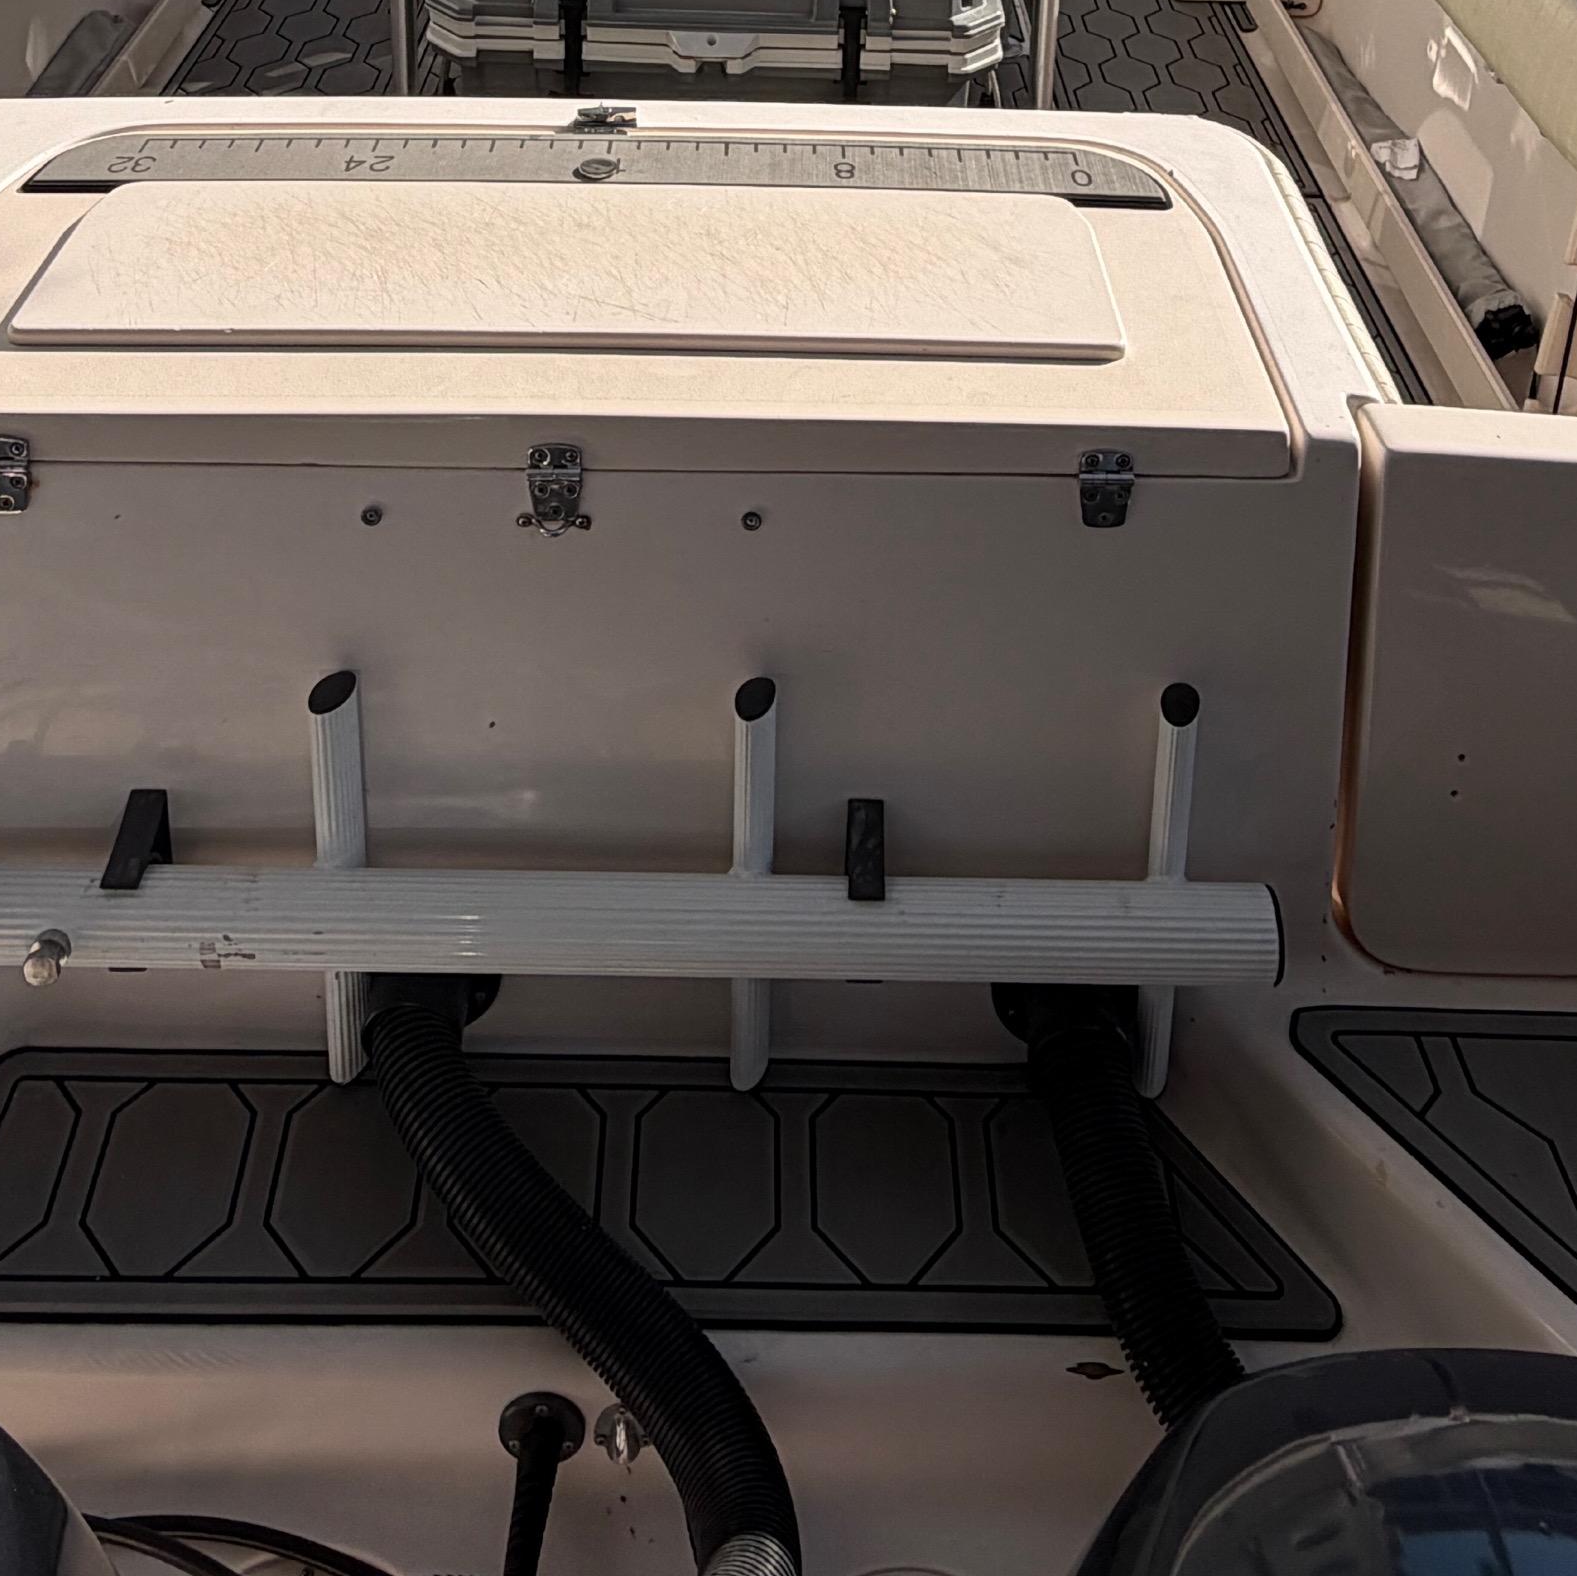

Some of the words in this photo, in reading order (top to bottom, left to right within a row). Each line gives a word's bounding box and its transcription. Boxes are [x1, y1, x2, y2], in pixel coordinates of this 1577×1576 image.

[107, 155, 157, 173] 32
[343, 154, 395, 173] 24
[833, 162, 856, 179] 8
